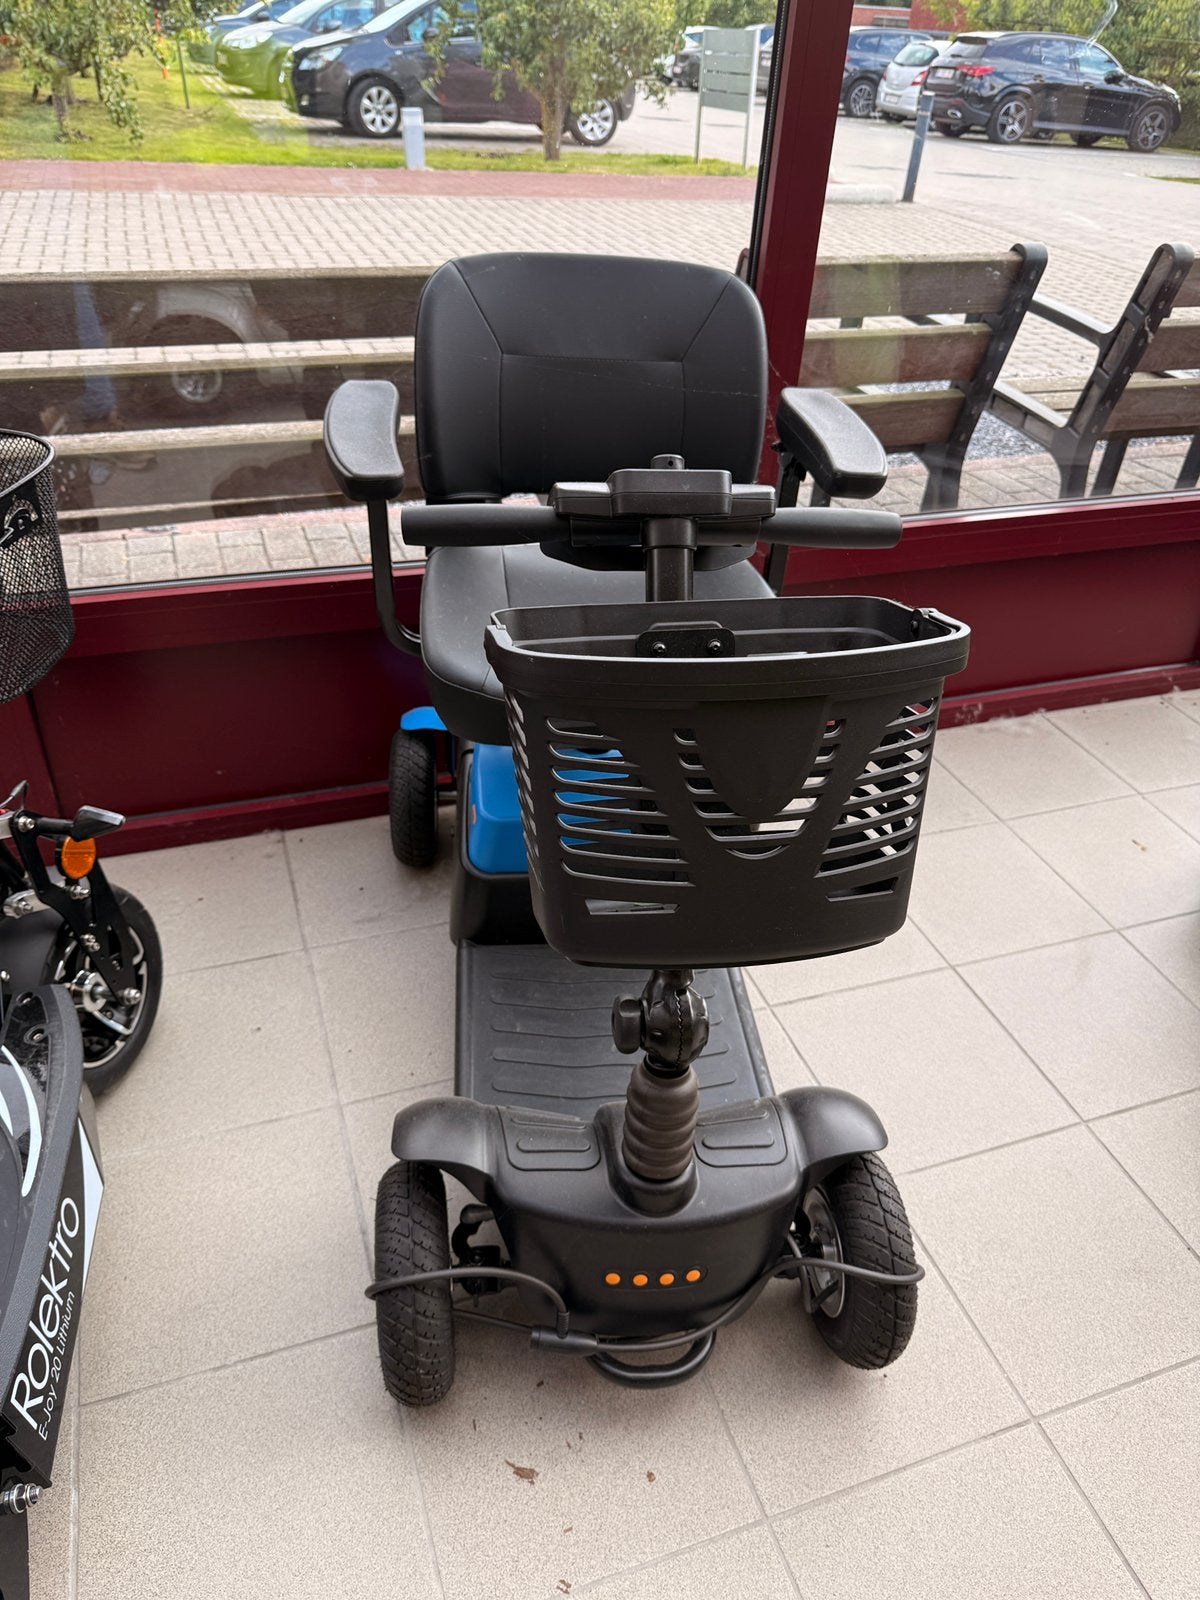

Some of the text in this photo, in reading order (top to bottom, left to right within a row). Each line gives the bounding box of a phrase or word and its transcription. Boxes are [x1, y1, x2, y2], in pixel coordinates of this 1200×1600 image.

[10, 1197, 80, 1430] Rolektro
[38, 1291, 75, 1441] E-Joy 20 Lithium
